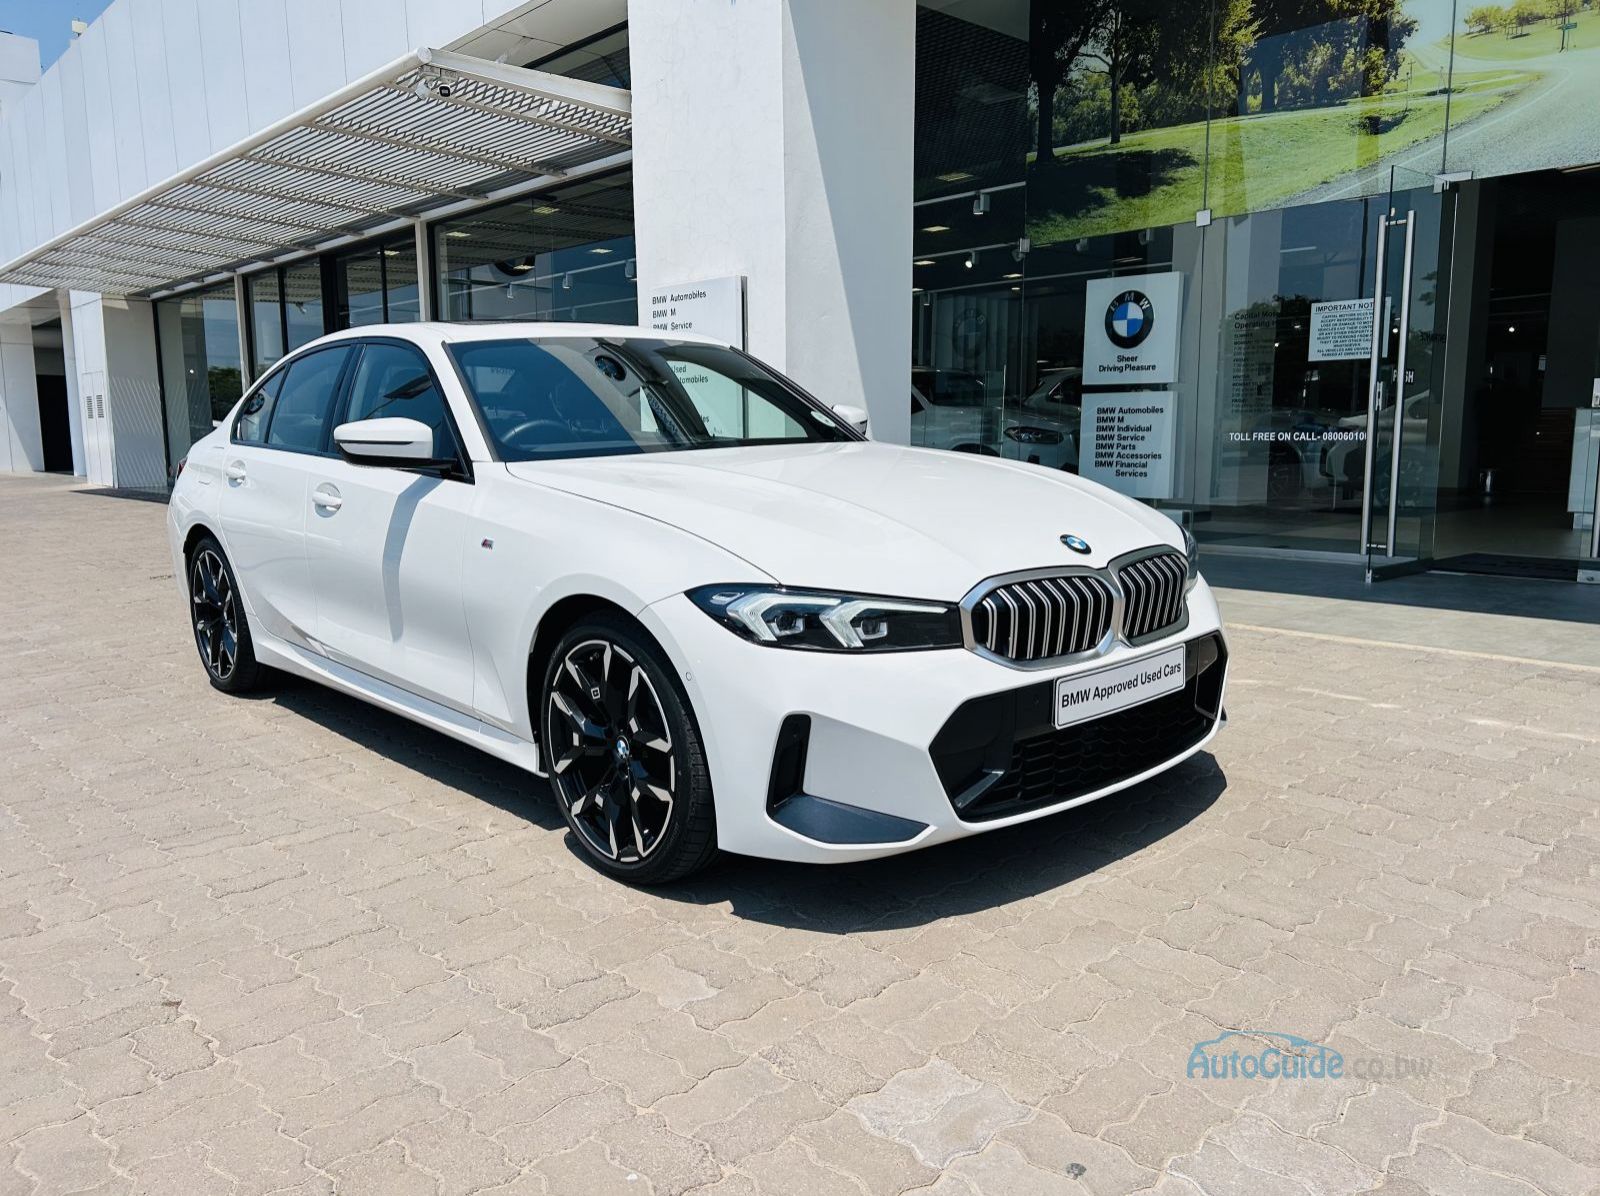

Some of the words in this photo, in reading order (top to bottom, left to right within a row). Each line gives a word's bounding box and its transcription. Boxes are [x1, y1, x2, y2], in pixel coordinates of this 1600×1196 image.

[652, 294, 667, 304] BMW
[670, 290, 706, 302] Automobiles
[652, 309, 667, 318] BMW
[670, 308, 676, 316] M
[1316, 304, 1356, 312] IMPORTANT
[671, 321, 692, 331] Service
[1099, 364, 1123, 373] Driving
[679, 374, 708, 384] tomobiles
[1118, 406, 1164, 414] Automobiles
[1229, 432, 1250, 441] TOLL
[1252, 432, 1276, 441] FREE
[1278, 432, 1291, 441] ON
[1293, 432, 1321, 441] CALL-
[1061, 688, 1091, 708] BMW
[1092, 674, 1138, 701] Approved
[1140, 667, 1161, 685] Used
[1163, 663, 1181, 677] Cars
